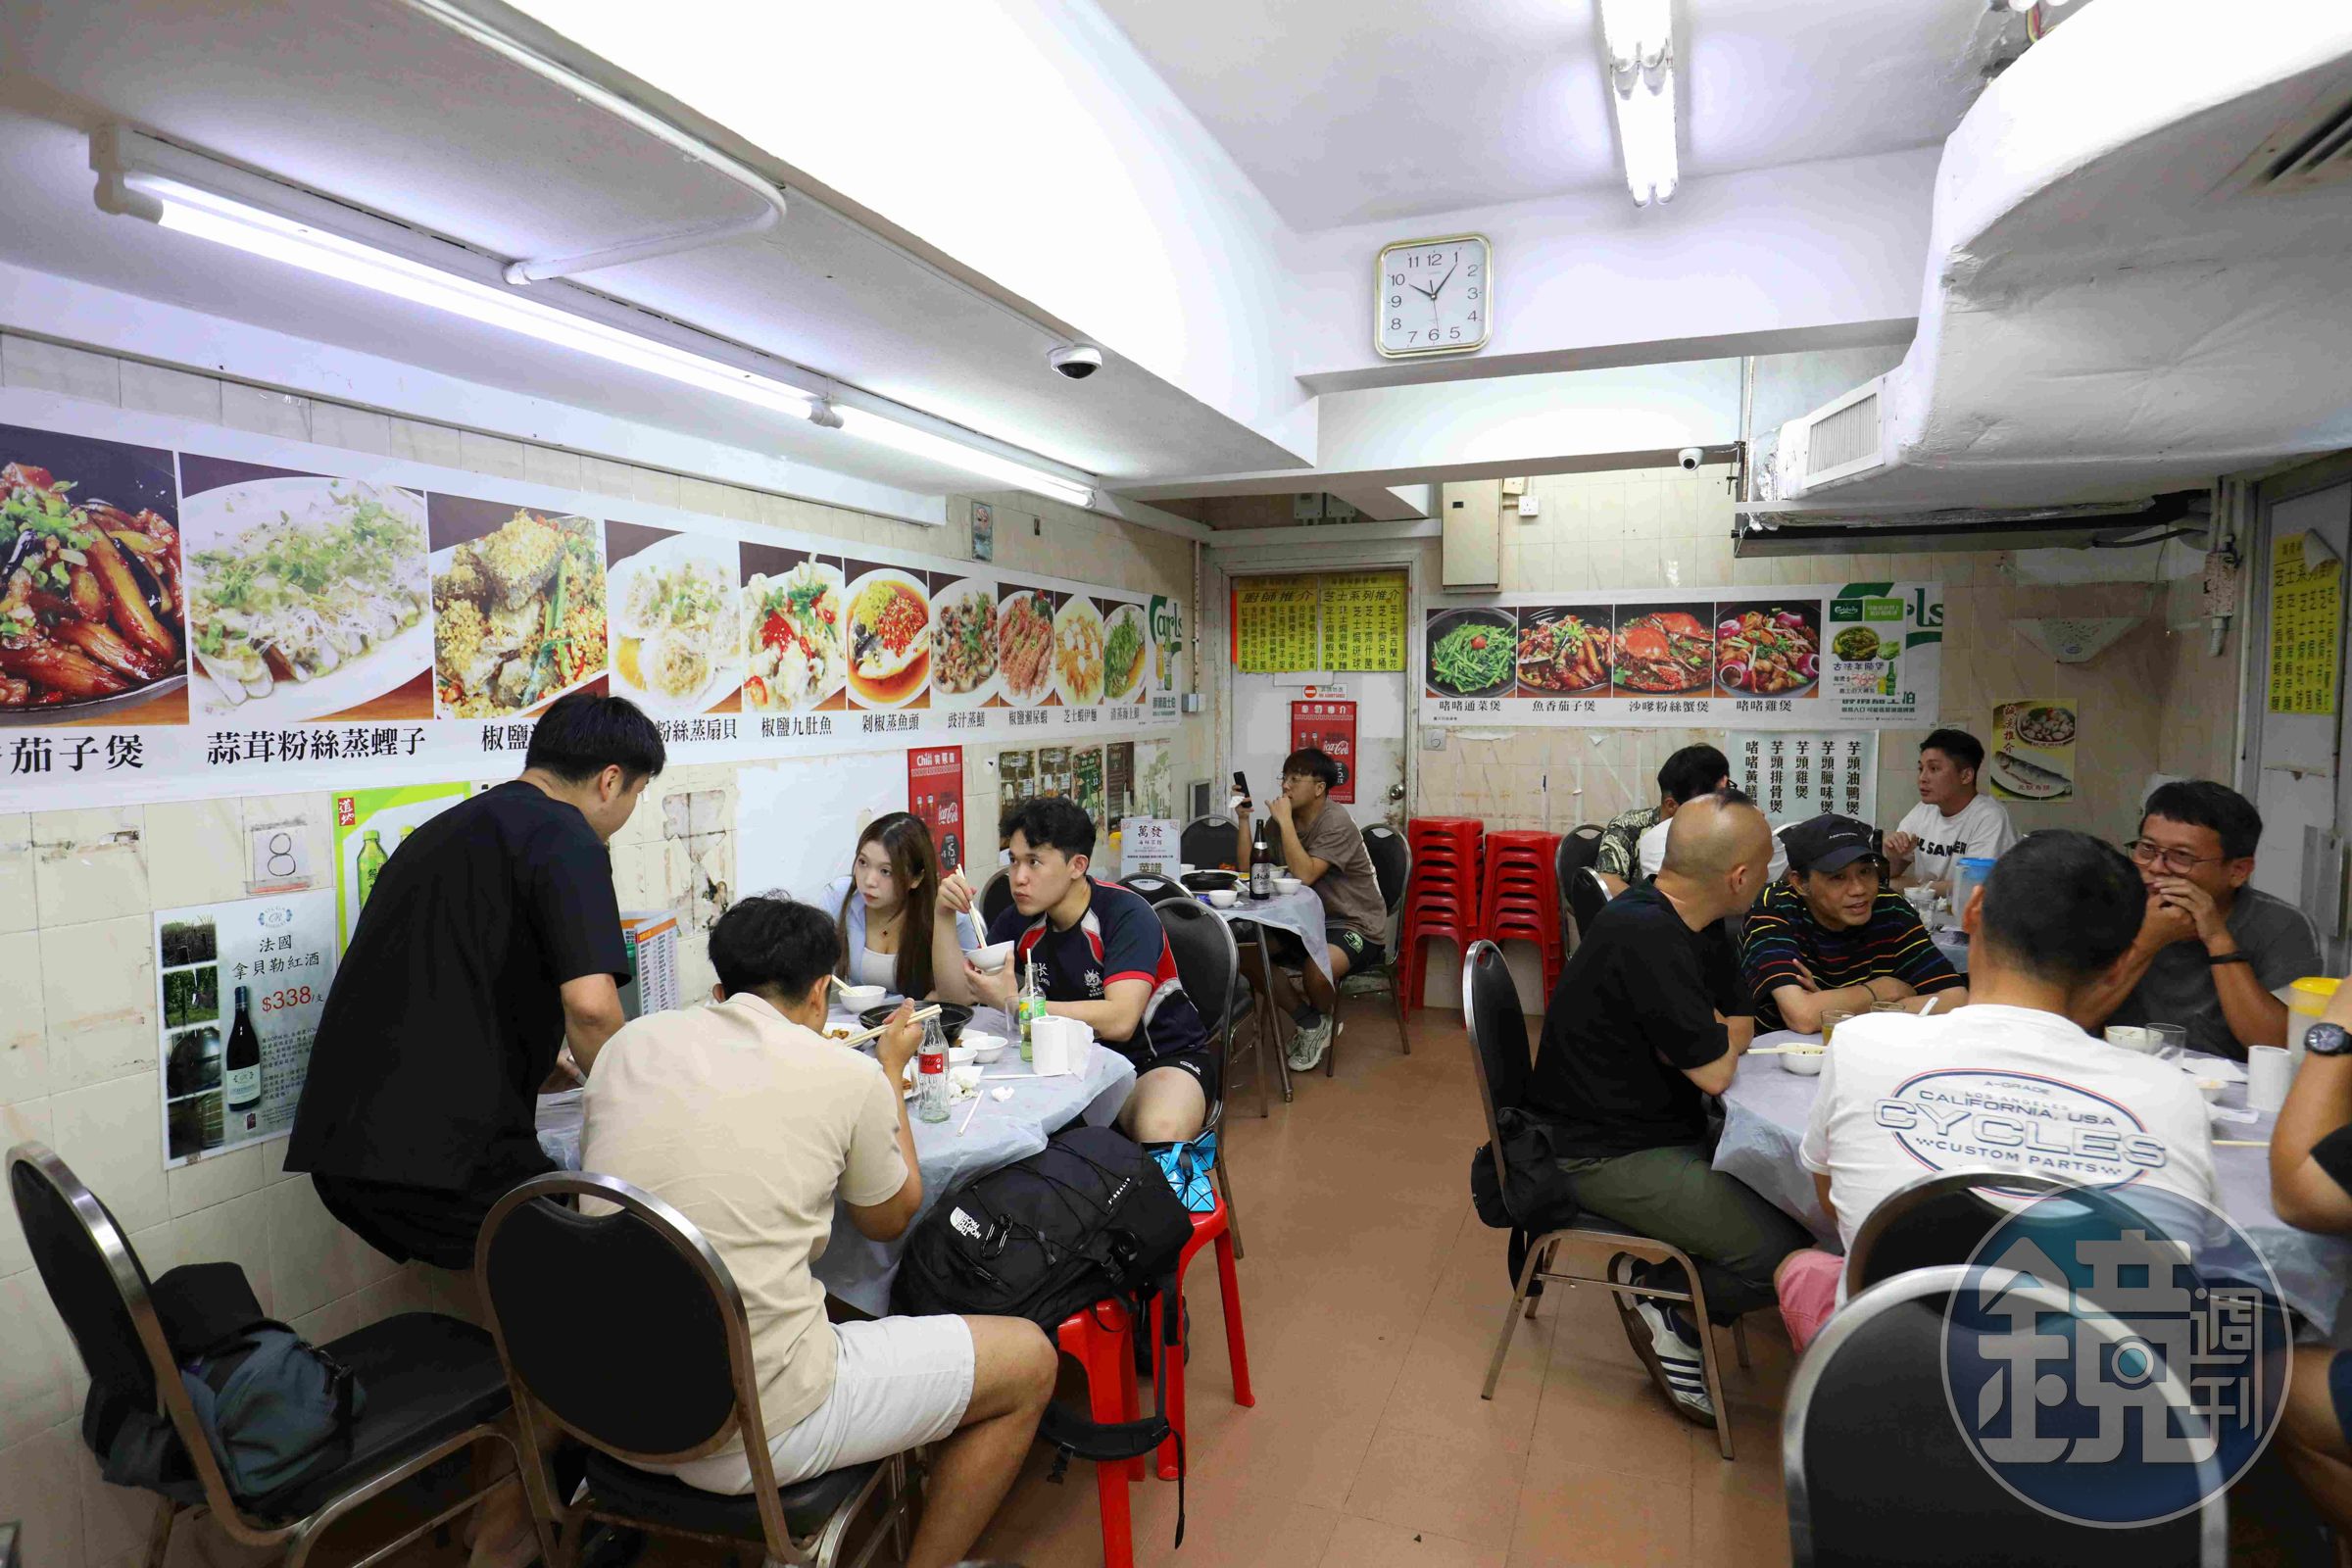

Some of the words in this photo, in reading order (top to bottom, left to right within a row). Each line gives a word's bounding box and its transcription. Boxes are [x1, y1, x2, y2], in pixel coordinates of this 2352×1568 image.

[1408, 256, 1419, 269] 11
[1427, 253, 1443, 267] 12
[1467, 265, 1478, 276] 2
[1392, 273, 1405, 286] 10
[1467, 287, 1478, 300] 3
[1391, 295, 1401, 308] 9
[1467, 310, 1478, 321] 4
[1391, 318, 1401, 330] 8
[1407, 331, 1418, 343] 7
[1429, 329, 1440, 341] 6
[1449, 327, 1460, 339] 5
[1243, 590, 1315, 604] 廚師推介
[1324, 589, 1400, 603] 芝士系列推介
[1439, 700, 1501, 712] 啫啫通菜煲
[1532, 700, 1595, 712] 魚香茄子煲
[1736, 699, 1792, 713] 啫啫雞煲
[760, 713, 833, 739] 椒鹽九肚魚
[861, 712, 920, 734] 剁椒蒸魚頭
[480, 722, 534, 753] 椒鹽
[0, 732, 145, 774] 茄子煲
[1770, 740, 1784, 814] 芋頭排骨煲
[1795, 740, 1809, 800] 芋頭雞煲
[1846, 741, 1862, 815] 芋頭油鴨煲
[268, 833, 296, 876] 8
[1927, 840, 1968, 857] SANER
[259, 935, 292, 953] 法國
[231, 952, 319, 980] 拿貝勒紅酒
[1984, 1080, 2052, 1096] A-GRADE
[1919, 1090, 2059, 1120] CALIFORNIA,
[2068, 1112, 2118, 1127] USA
[1874, 1098, 2168, 1168] CYCLES
[1936, 1141, 2021, 1162] CUSTOM
[2029, 1155, 2099, 1174] PARTS
[962, 1214, 980, 1229] FACE
[955, 1225, 968, 1237] THE
[958, 1219, 982, 1239] NORTH
